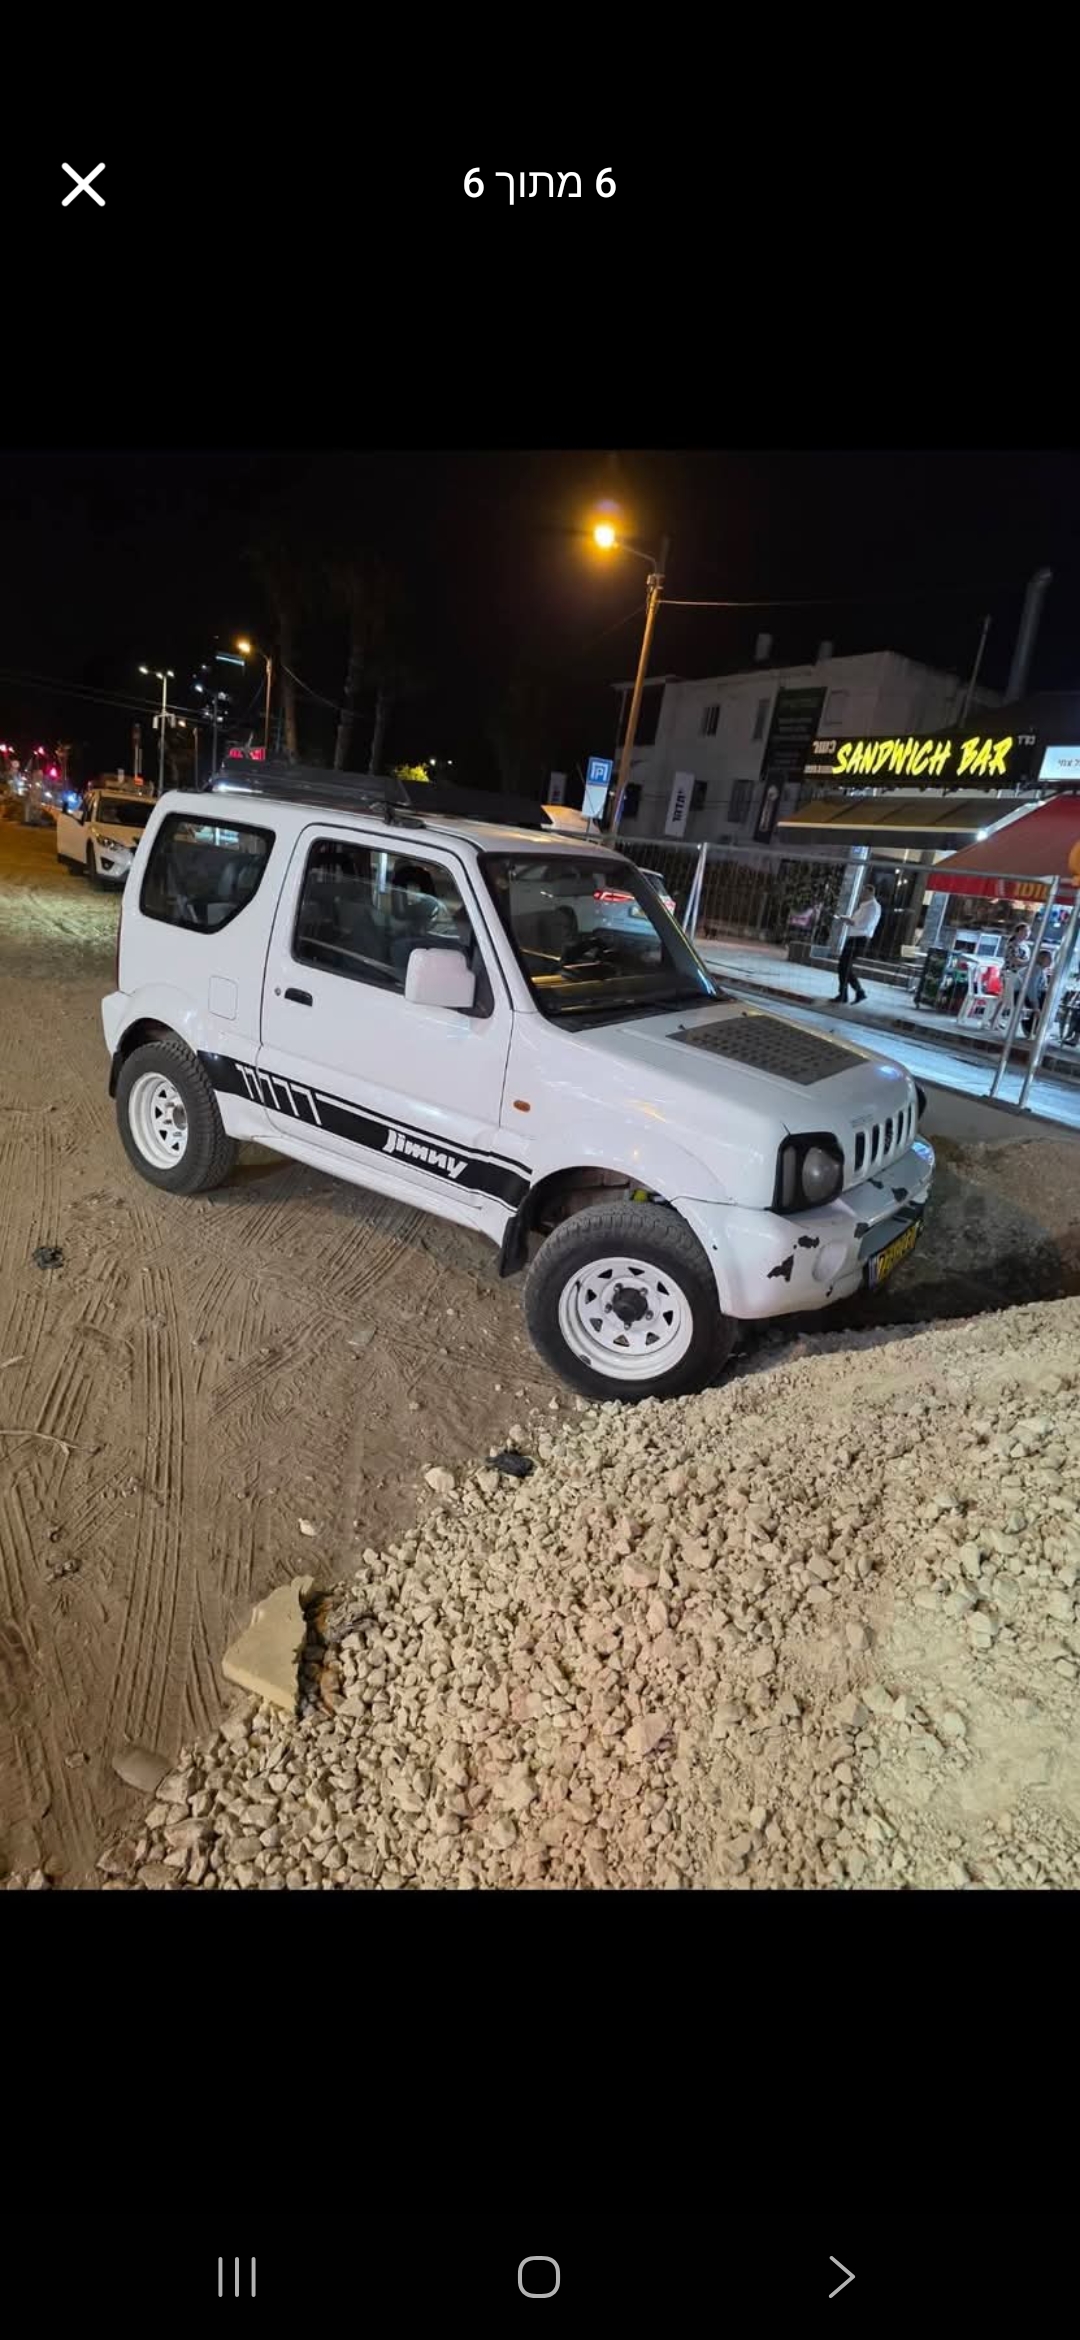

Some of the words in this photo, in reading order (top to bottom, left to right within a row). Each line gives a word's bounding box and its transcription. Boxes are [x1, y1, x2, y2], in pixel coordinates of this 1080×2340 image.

[812, 740, 836, 754] כשר
[832, 738, 950, 776] SANDWICH
[956, 736, 1013, 776] BAR
[382, 1129, 469, 1179] Jimny
